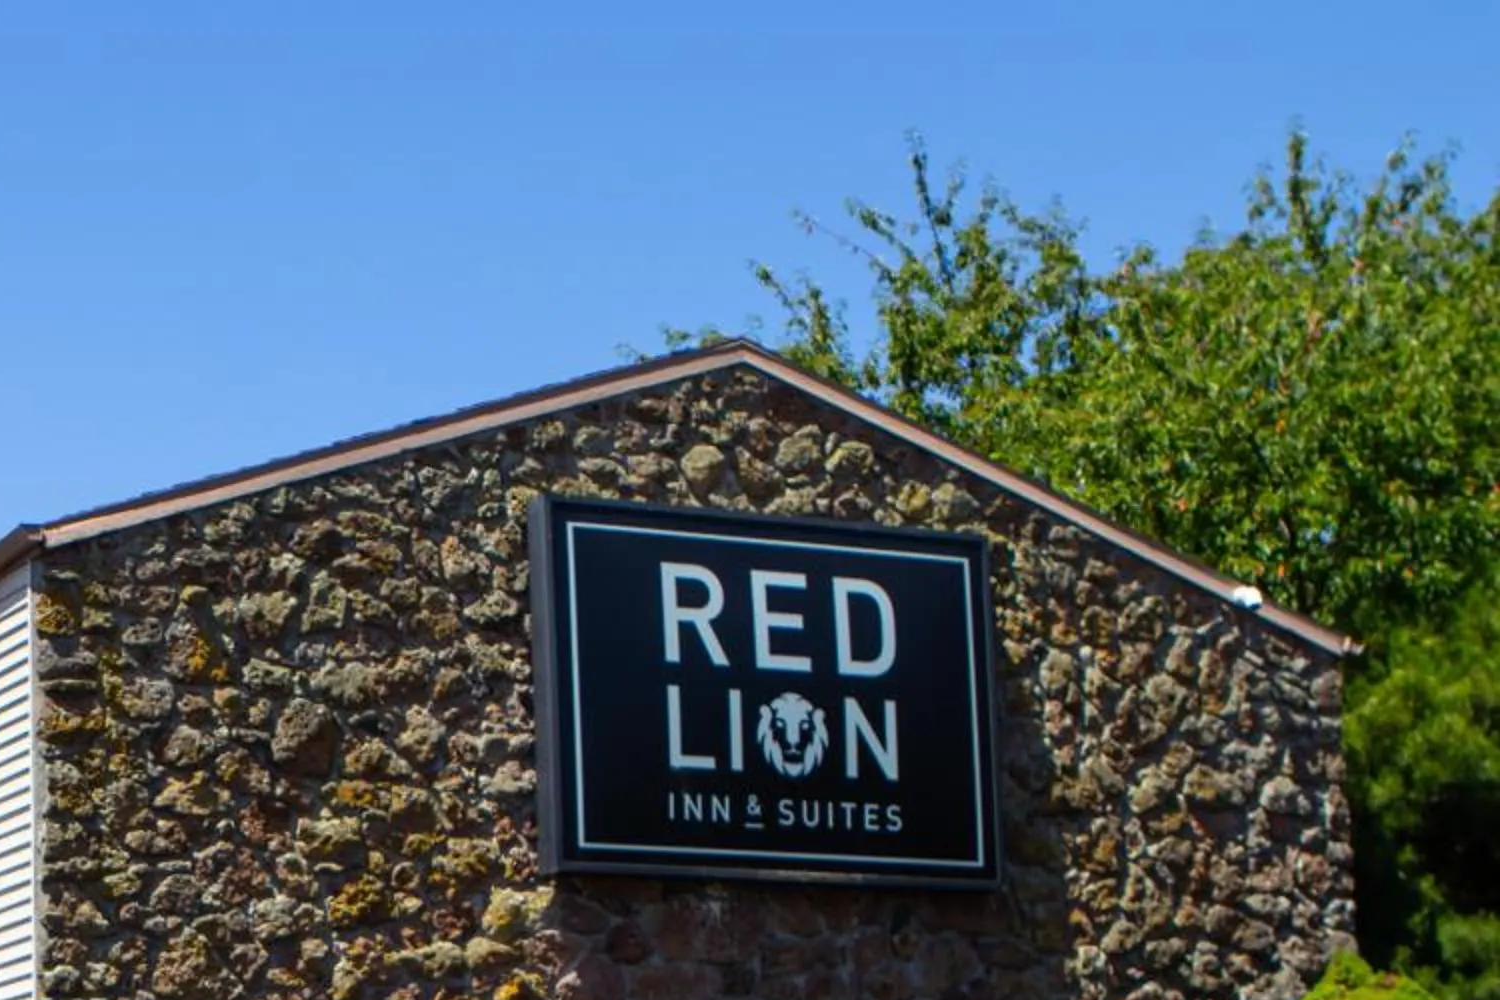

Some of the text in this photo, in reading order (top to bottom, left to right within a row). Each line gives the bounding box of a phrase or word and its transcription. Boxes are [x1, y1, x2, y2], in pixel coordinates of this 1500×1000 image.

[659, 560, 898, 678] RED
[666, 684, 900, 782] LION
[668, 791, 904, 832] INN & SUITES
